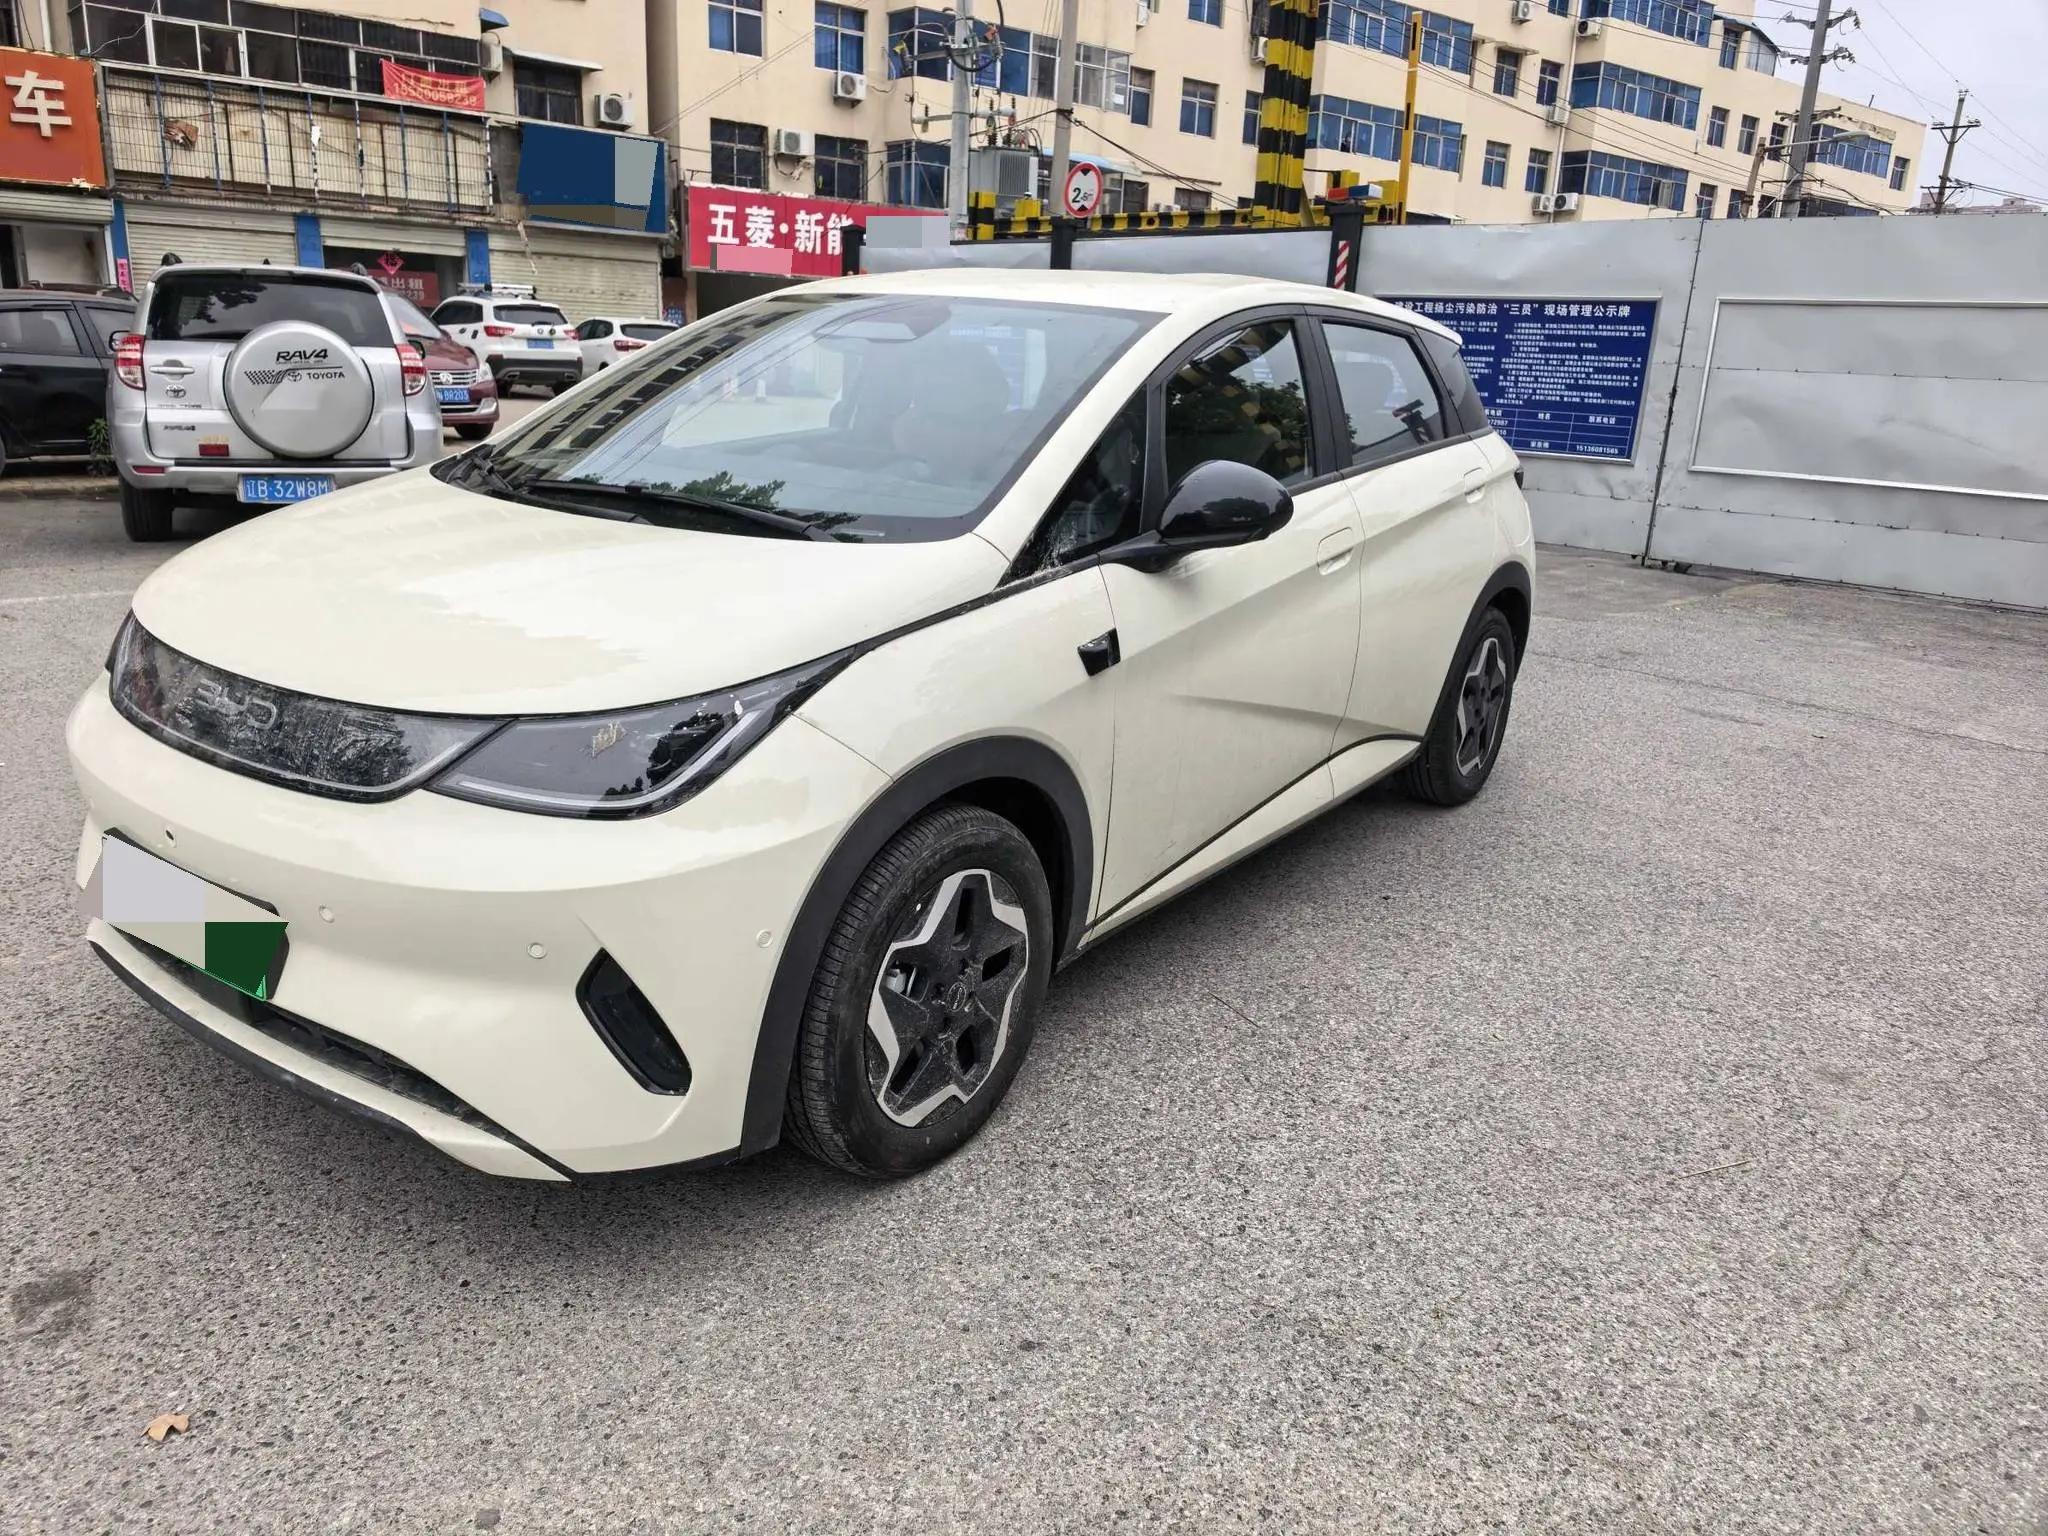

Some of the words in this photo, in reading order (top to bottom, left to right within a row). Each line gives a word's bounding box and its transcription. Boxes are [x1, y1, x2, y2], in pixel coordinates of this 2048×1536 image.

[4, 69, 73, 137] 车
[276, 349, 328, 361] RAV4
[307, 371, 346, 380] TOYOTA
